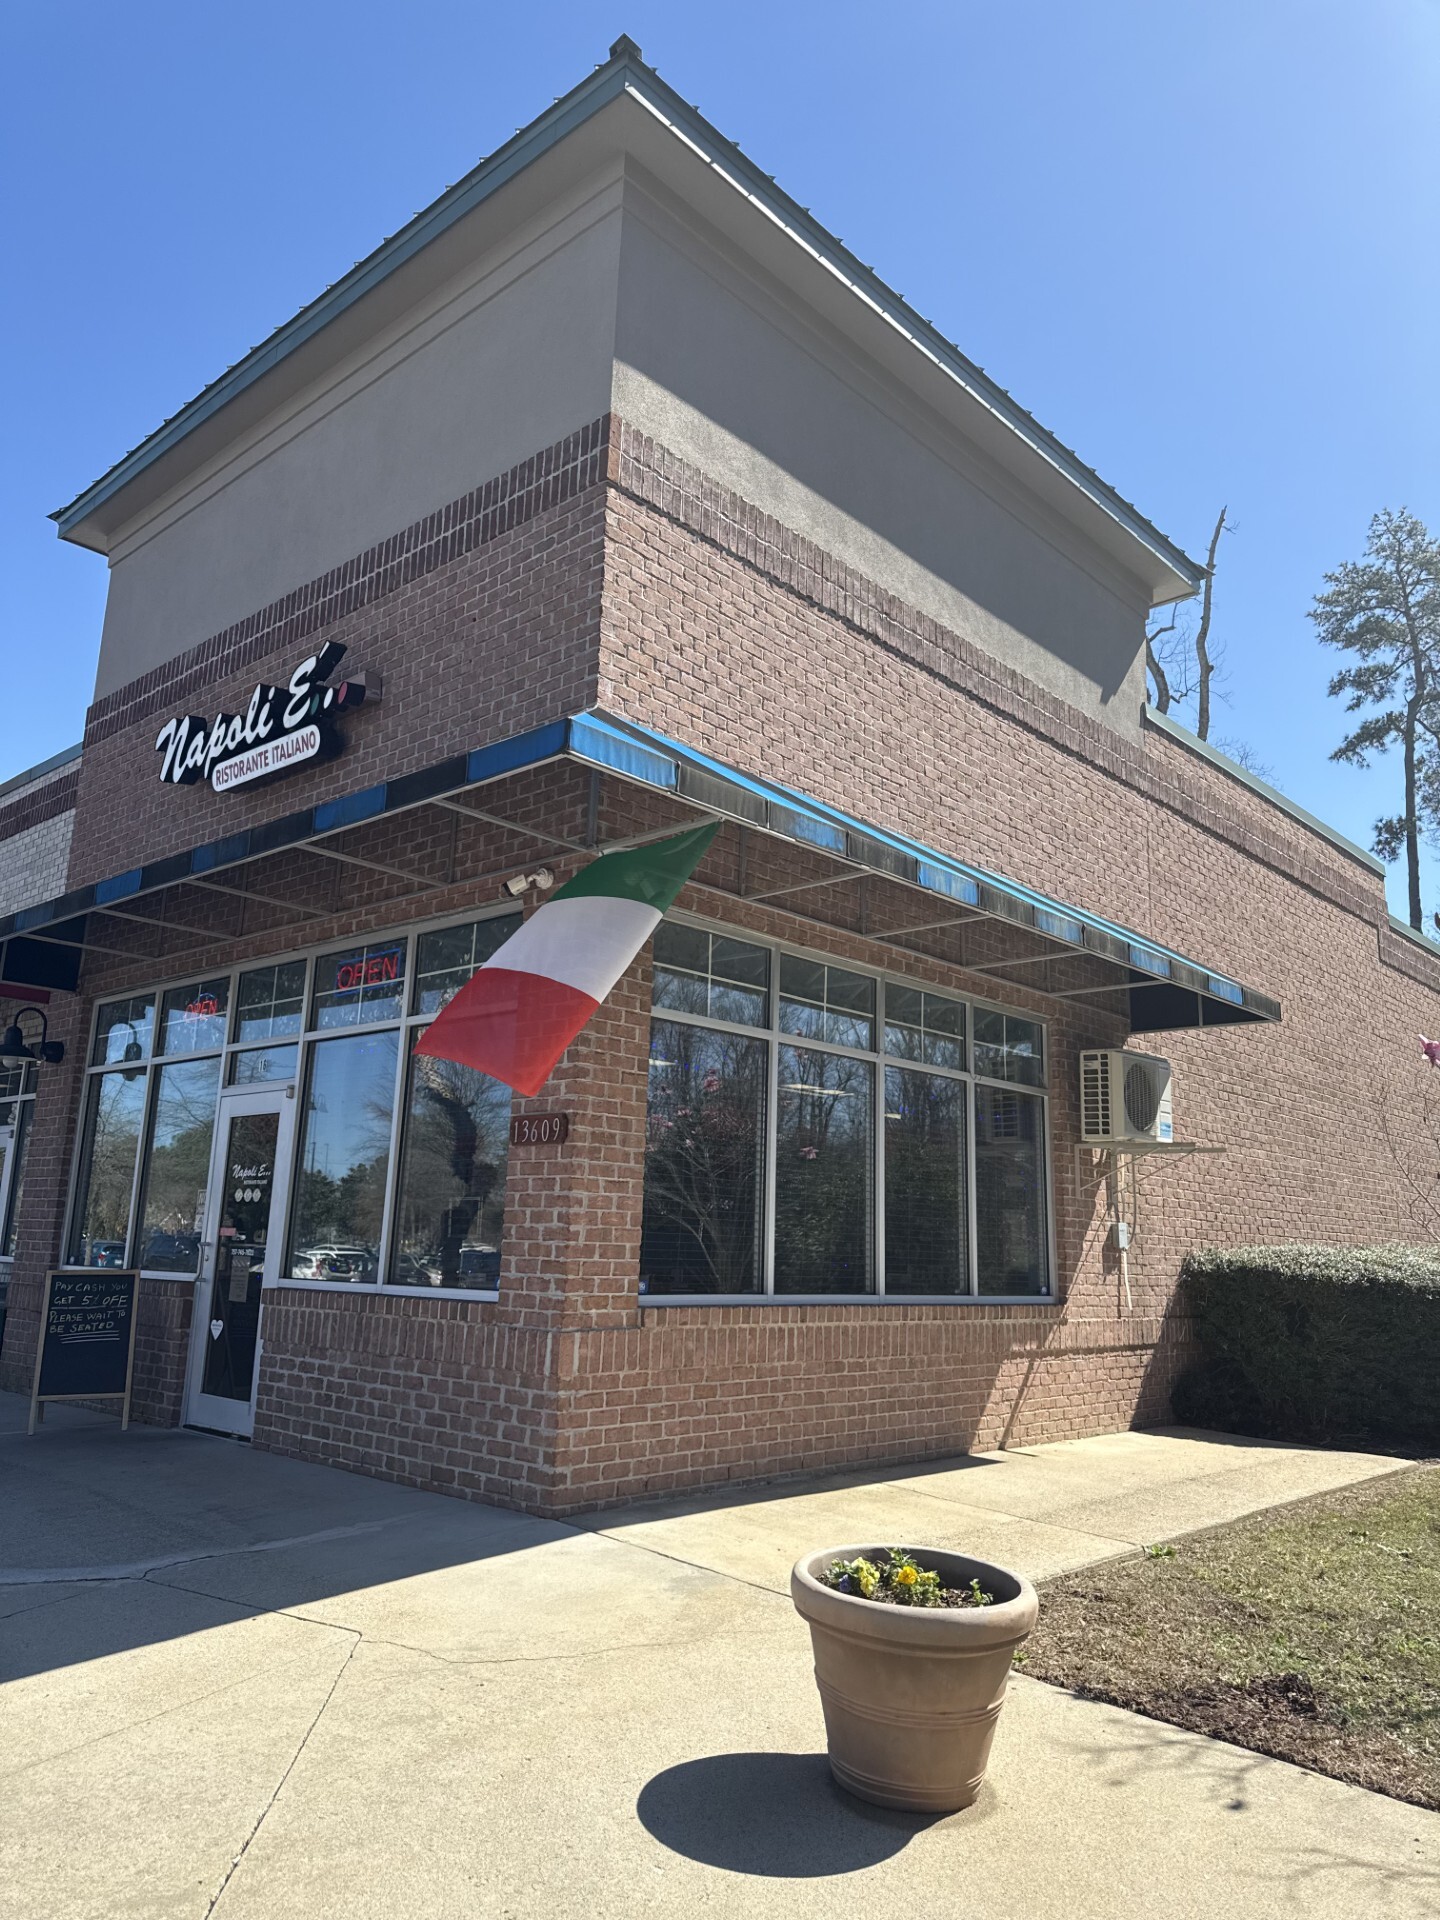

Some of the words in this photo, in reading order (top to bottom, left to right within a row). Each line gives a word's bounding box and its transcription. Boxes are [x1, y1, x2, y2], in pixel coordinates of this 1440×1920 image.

[155, 683, 274, 783] Napoli
[215, 751, 270, 786] RISTORANTE
[271, 731, 317, 763] ITALIANO
[336, 955, 399, 990] OPEN
[183, 999, 219, 1023] OPEN
[513, 1117, 560, 1143] 13609
[232, 1164, 257, 1180] Napoli
[54, 1281, 74, 1292] PAY
[75, 1283, 106, 1292] CASH
[111, 1283, 128, 1291] YOU
[53, 1295, 75, 1305] GET
[102, 1295, 129, 1306] OFF
[49, 1310, 83, 1323] PLEASE
[86, 1310, 114, 1320] WAIT
[116, 1309, 126, 1318] TO
[49, 1325, 65, 1334] BE
[70, 1321, 115, 1333] SEATED
